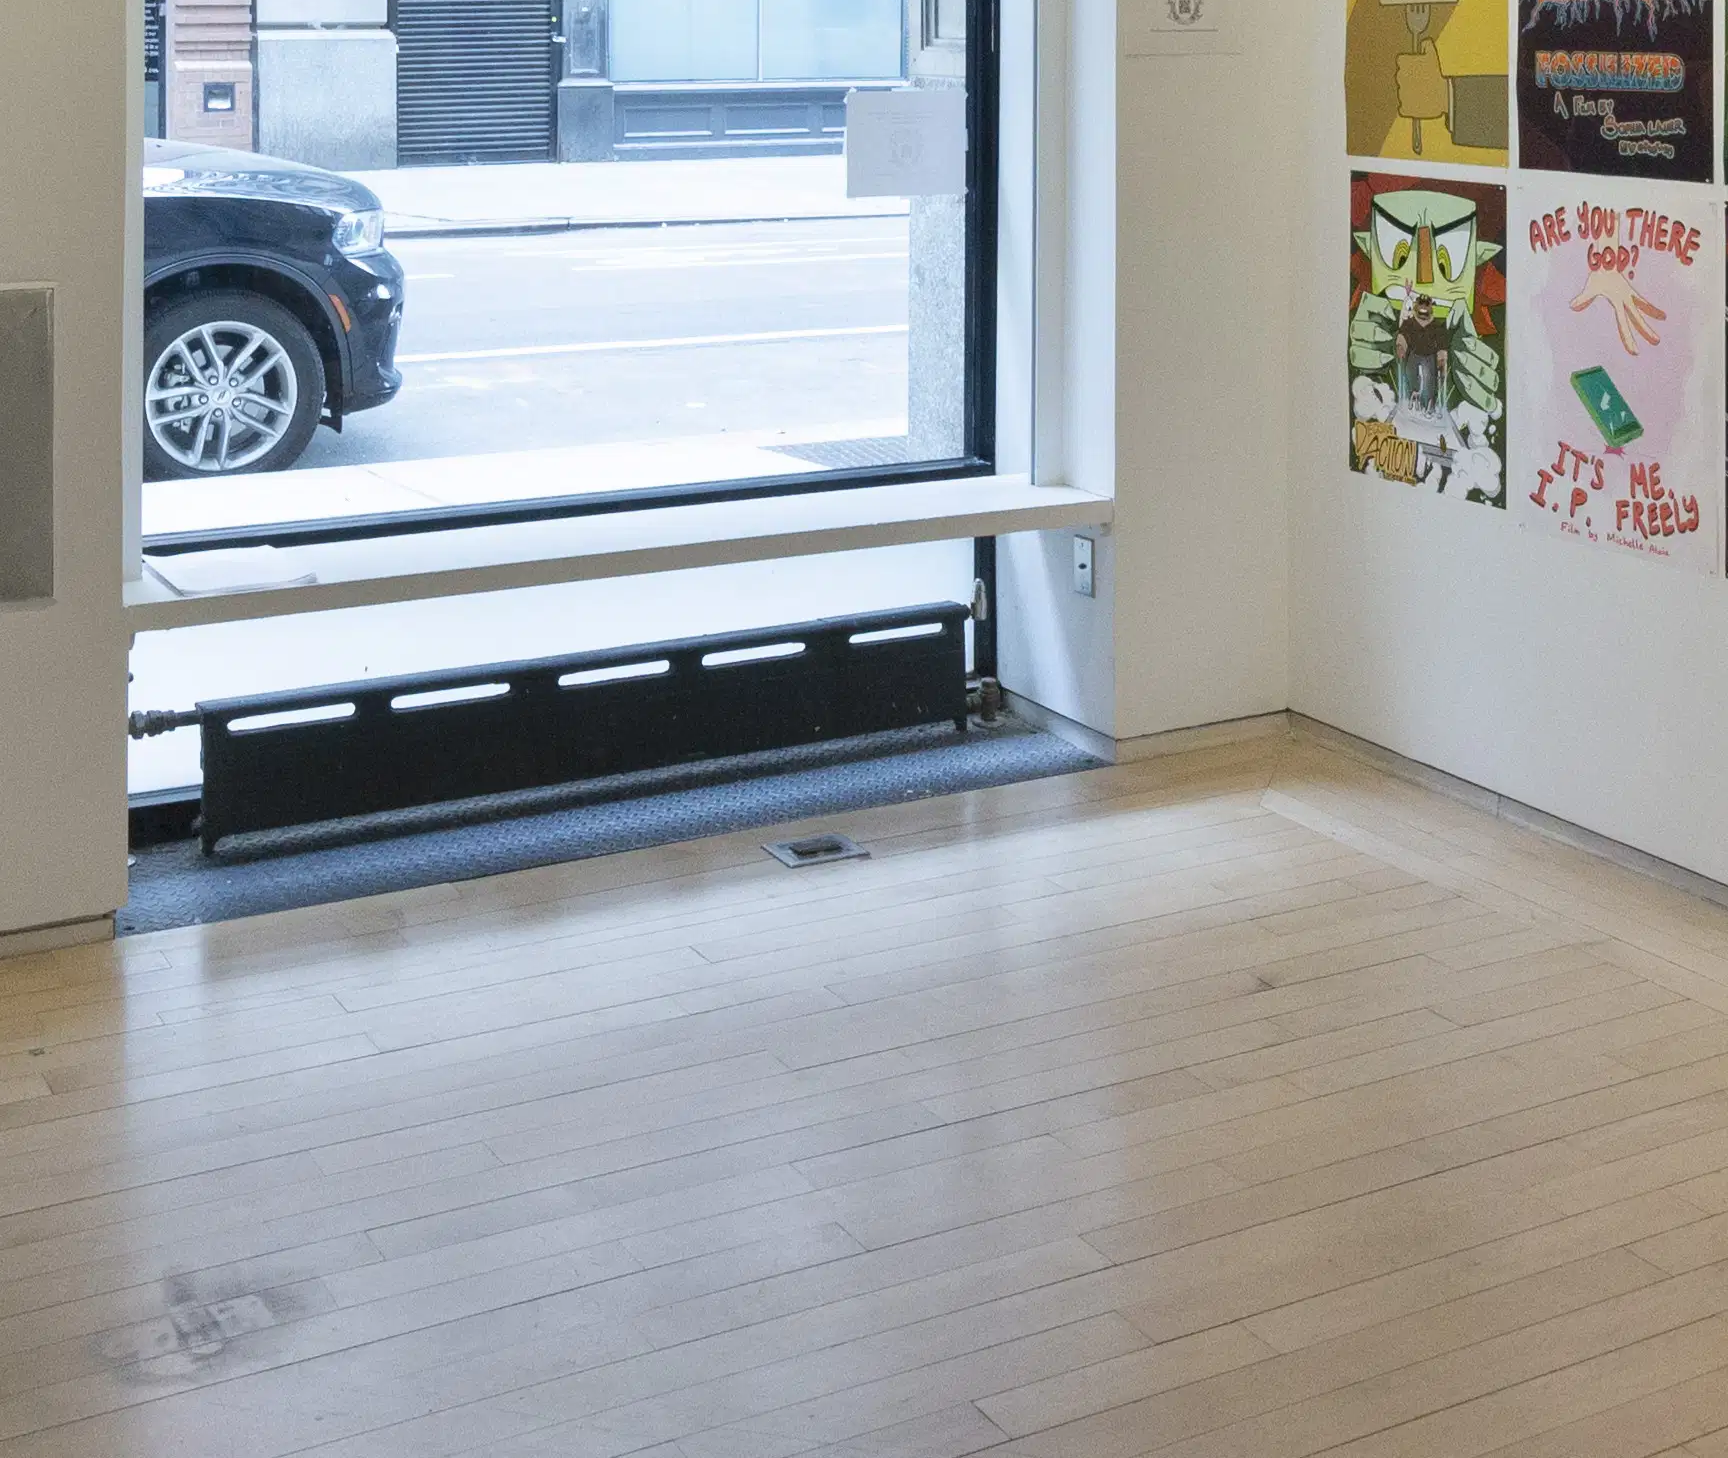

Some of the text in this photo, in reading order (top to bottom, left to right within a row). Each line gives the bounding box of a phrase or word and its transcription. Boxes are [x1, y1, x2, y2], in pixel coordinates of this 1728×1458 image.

[1535, 50, 1685, 92] FOSSILIZED
[1529, 201, 1700, 266] ARE YOU THERE
[1587, 243, 1639, 280] GOD?
[1551, 441, 1604, 490] IT'S
[1616, 494, 1700, 540] FREELY
